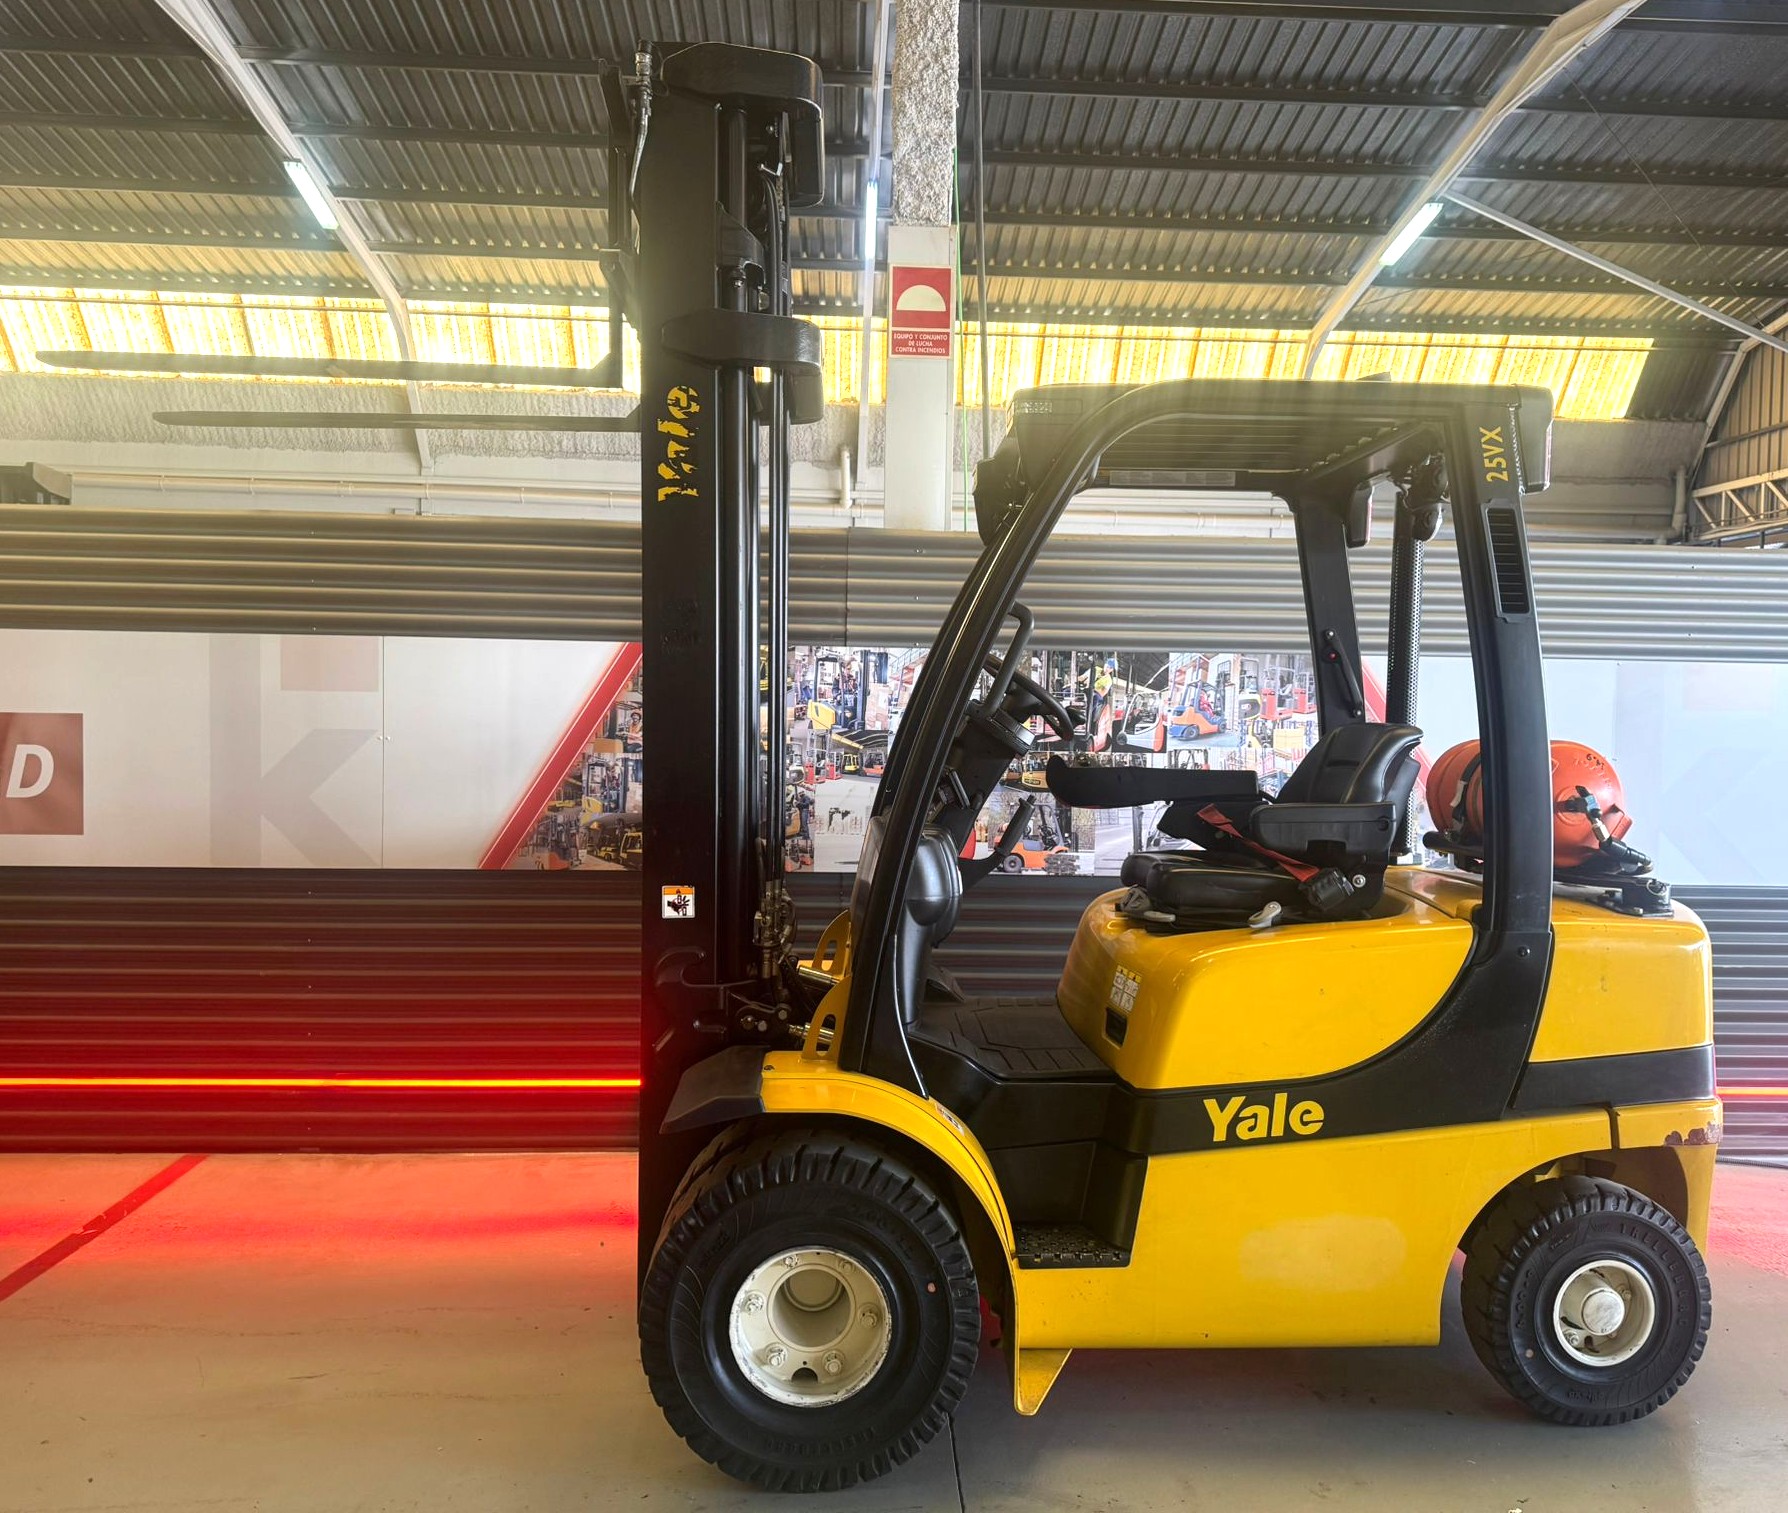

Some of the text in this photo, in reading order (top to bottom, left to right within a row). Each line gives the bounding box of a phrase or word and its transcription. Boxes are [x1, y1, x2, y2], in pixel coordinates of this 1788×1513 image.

[1479, 426, 1509, 482] 25VX
[5, 743, 55, 798] D
[1202, 1092, 1325, 1142] Yale
